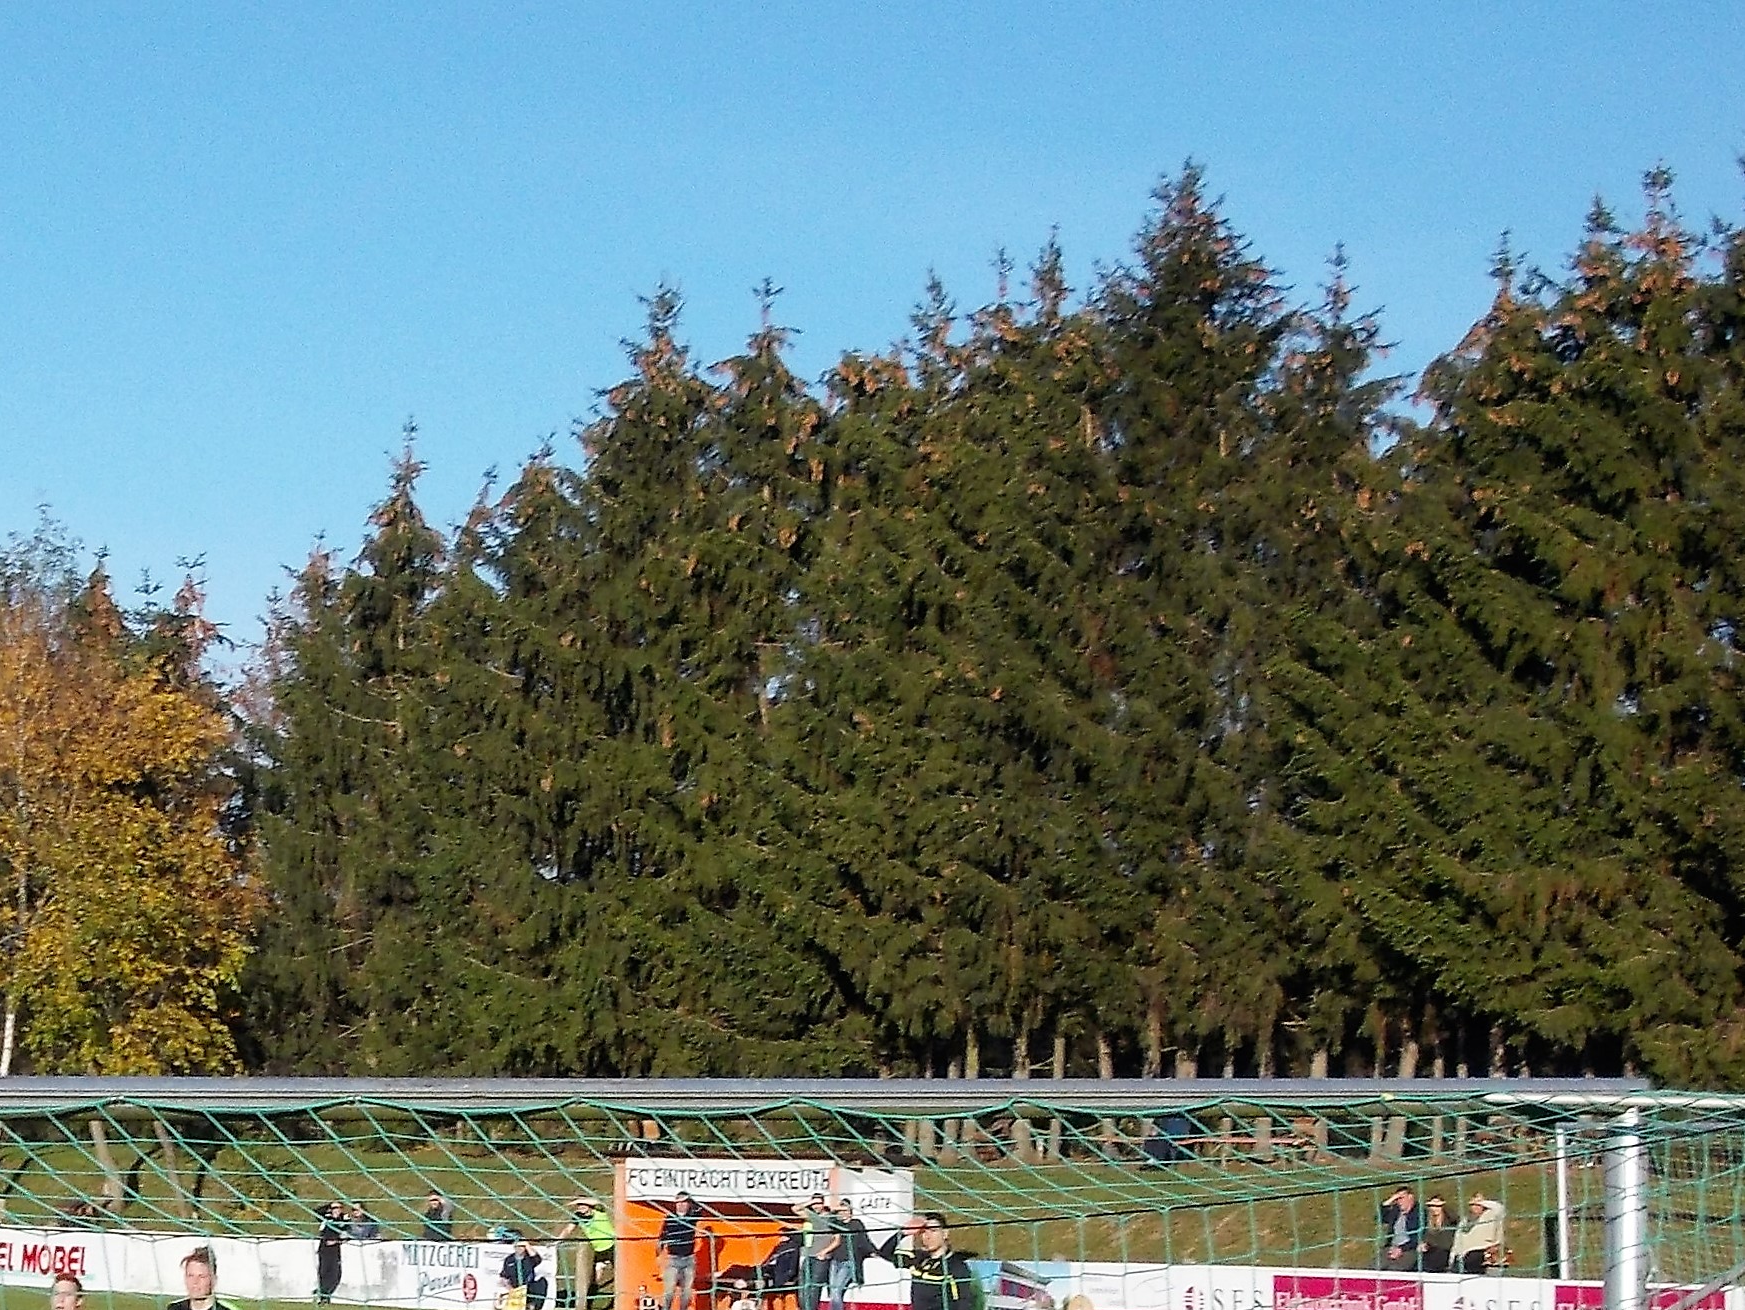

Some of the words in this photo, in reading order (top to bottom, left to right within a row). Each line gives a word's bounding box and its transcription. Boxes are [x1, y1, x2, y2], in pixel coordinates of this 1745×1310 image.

[628, 1168, 648, 1187] FC
[654, 1168, 741, 1189] EINTRACHT
[746, 1168, 831, 1189] BAYREUTH
[402, 1243, 480, 1269] METZGEREI
